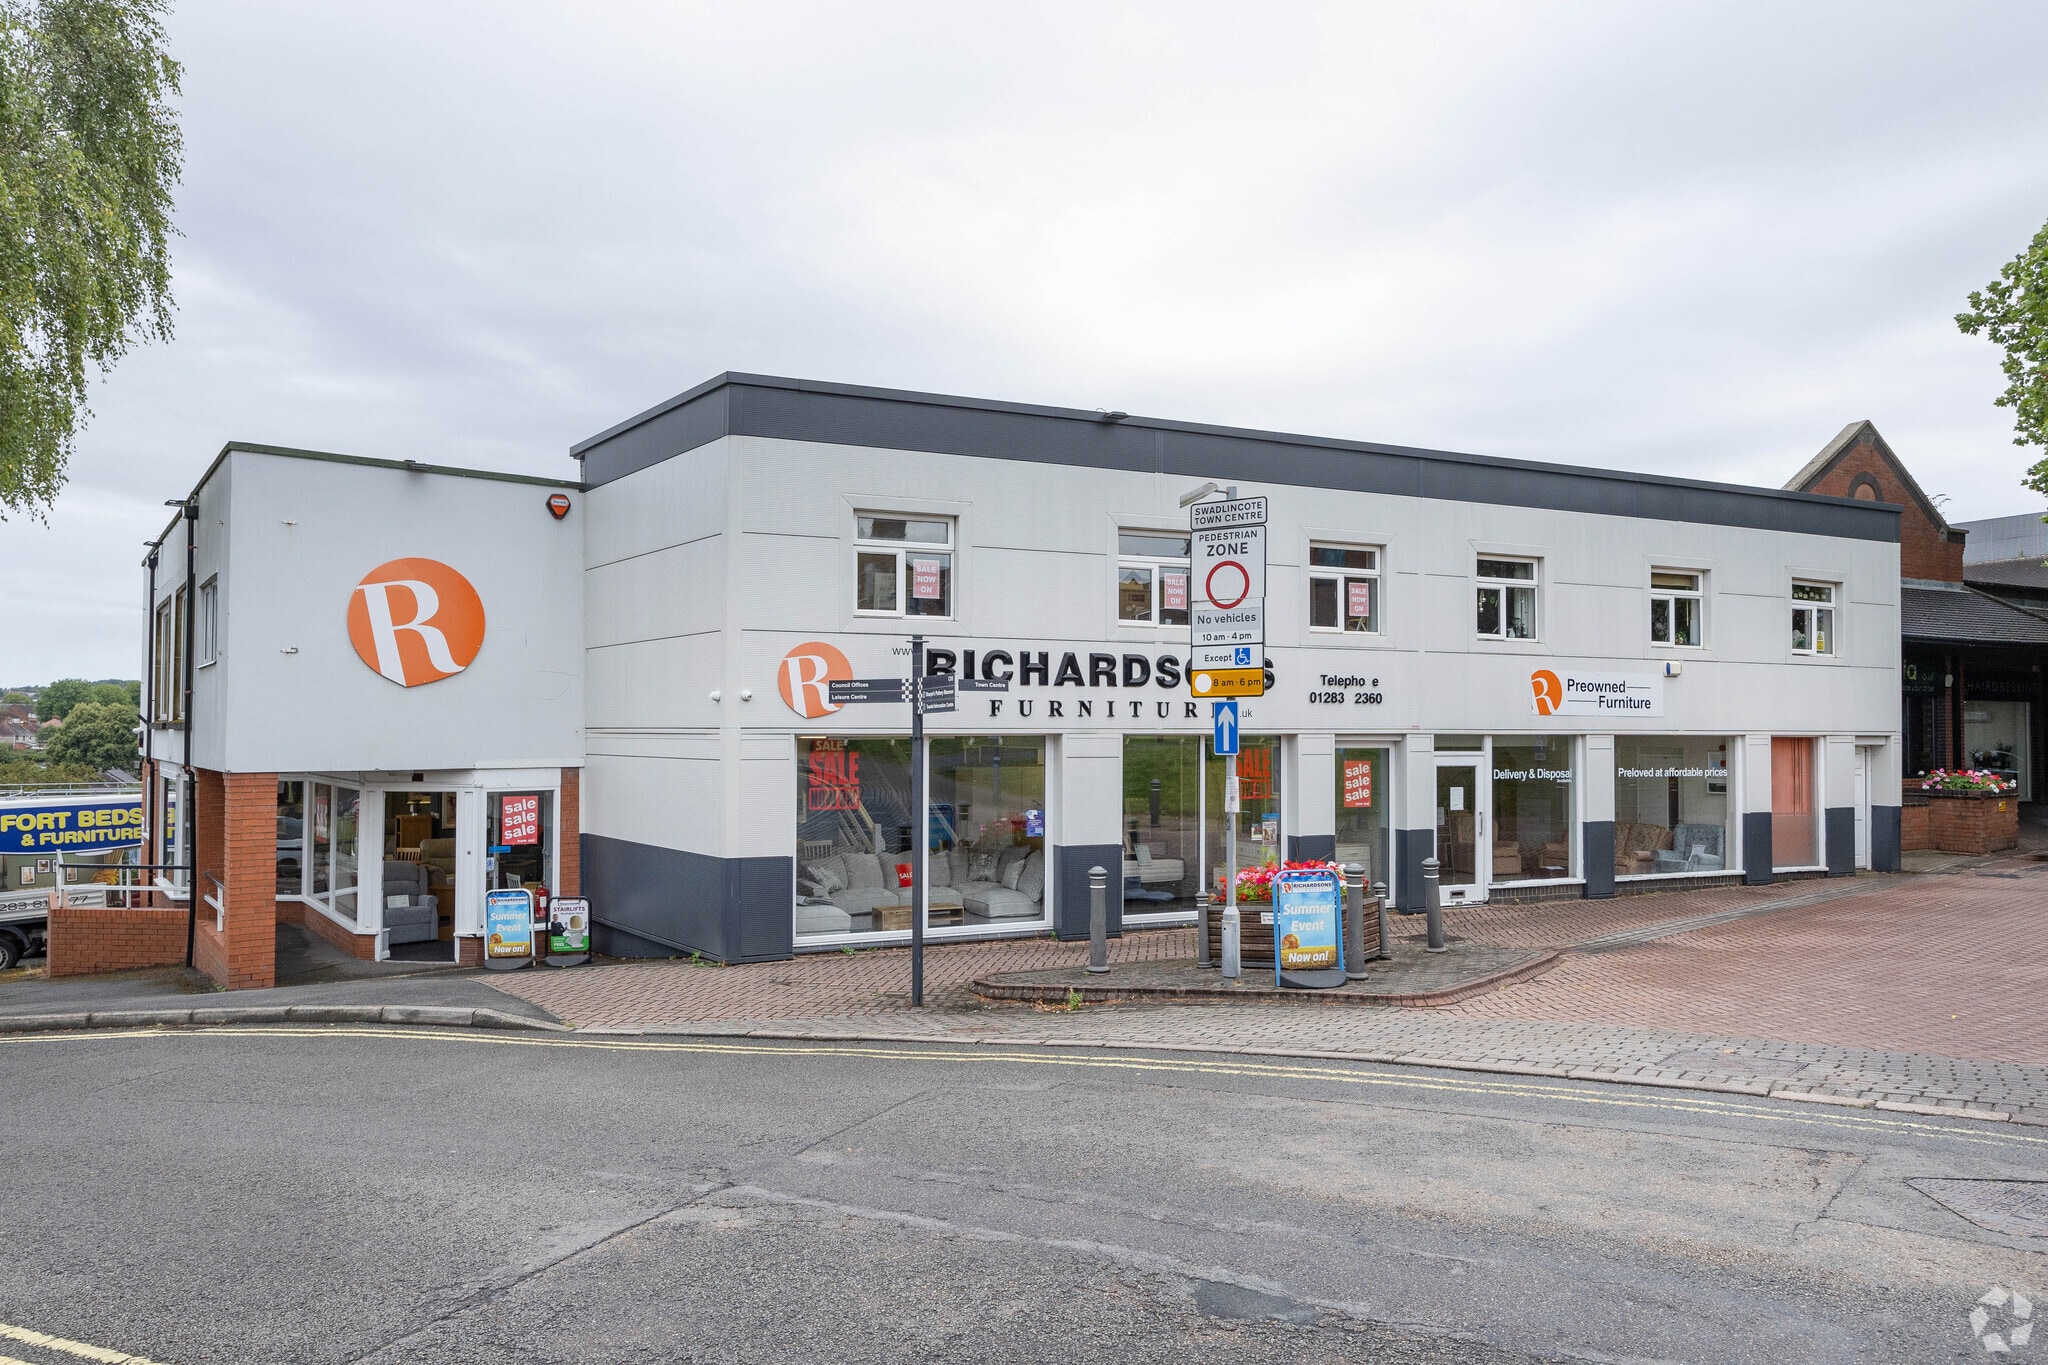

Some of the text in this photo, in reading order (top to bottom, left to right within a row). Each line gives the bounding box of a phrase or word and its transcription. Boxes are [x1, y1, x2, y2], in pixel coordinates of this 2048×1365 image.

[1195, 502, 1262, 516] SWADLINCOTE
[1194, 510, 1262, 525] TOWN CENTRE
[1199, 530, 1258, 542] PEDESTRIAN
[1206, 542, 1248, 556] ZONE
[1198, 613, 1256, 624] No vehicles
[356, 580, 466, 688] R
[1202, 634, 1212, 642] 10
[1232, 632, 1238, 640] 4
[1240, 632, 1252, 640] pm
[1204, 654, 1232, 662] Except
[926, 648, 1275, 690] RICHARDSS
[1248, 678, 1261, 687] pm
[1567, 678, 1626, 692] Preowned
[1967, 682, 2040, 694] HAIRDRESSING
[1310, 692, 1382, 704] 01283 2360
[1598, 696, 1651, 709] Furniture
[989, 700, 1214, 718] FURNITUR
[816, 740, 843, 750] SALE
[809, 752, 860, 786] SALE
[1346, 763, 1370, 778] sale
[1494, 768, 1572, 781] Delivery & Disposal
[1618, 767, 1728, 778] Preloved at affordable prices
[1346, 775, 1370, 790] sale
[1346, 788, 1370, 802] sale
[505, 798, 536, 814] sale
[0, 808, 142, 832] FORT BEDS
[505, 811, 536, 826] sale
[21, 827, 142, 847] & FURNITURE
[504, 824, 536, 840] sale
[900, 872, 912, 880] SALE
[490, 912, 526, 920] Summer
[1284, 904, 1332, 915] Summer
[496, 924, 522, 932] Event
[1291, 920, 1325, 932] Event
[1288, 950, 1328, 962] Now on!
